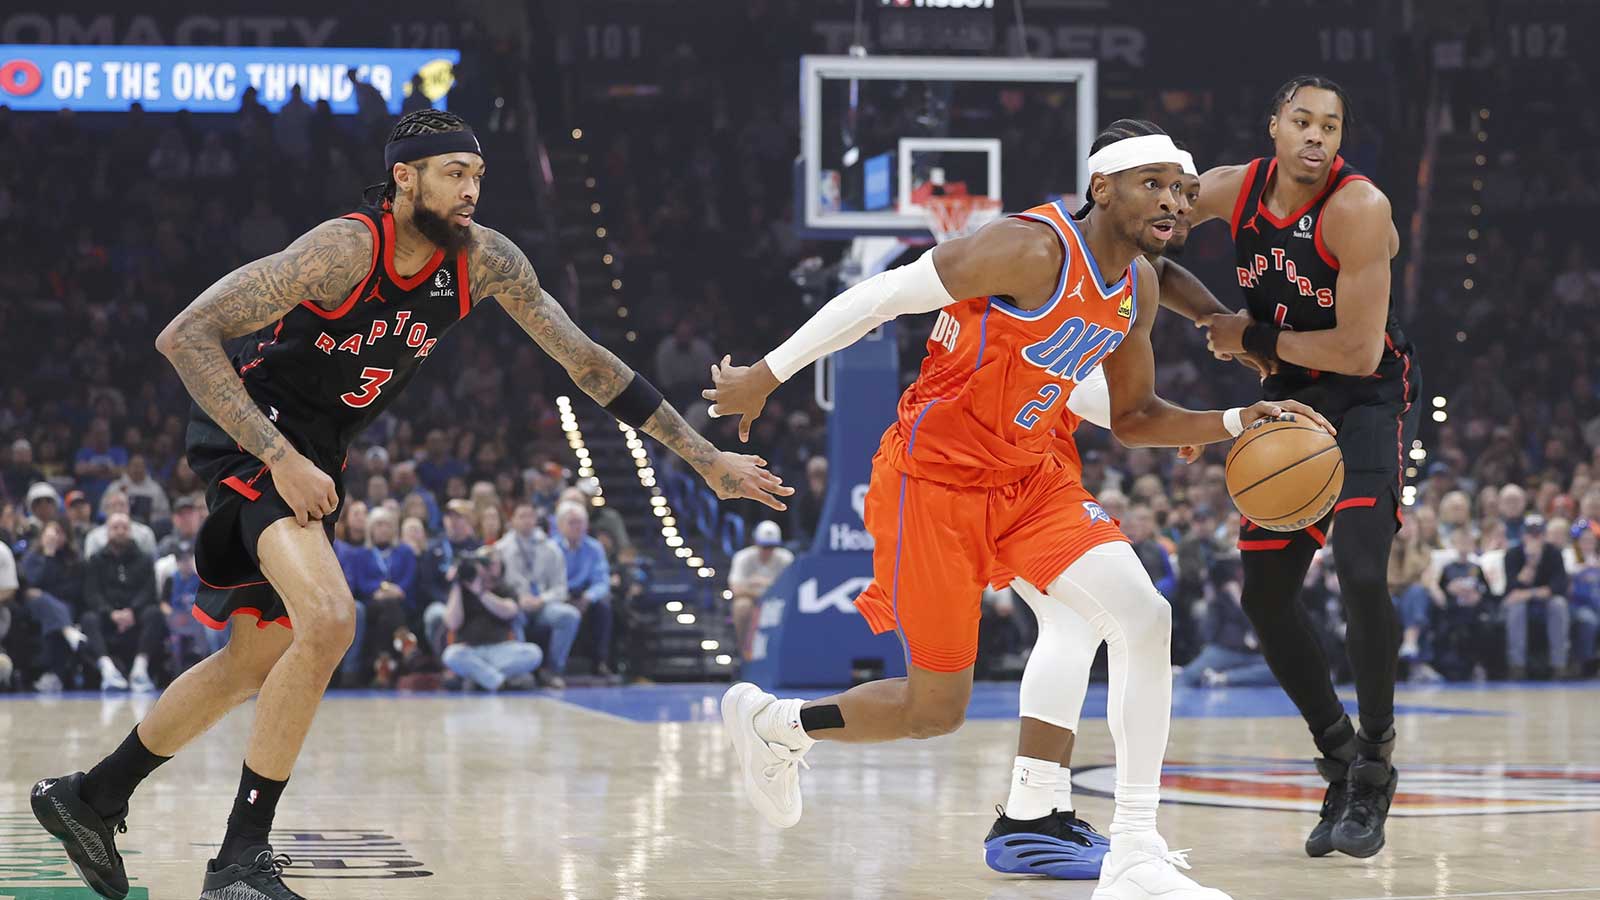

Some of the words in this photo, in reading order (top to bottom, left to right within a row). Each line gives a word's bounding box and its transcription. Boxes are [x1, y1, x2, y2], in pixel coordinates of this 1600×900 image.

[52, 61, 93, 100] OF
[102, 61, 162, 100] THE
[172, 62, 236, 101] OKC
[1236, 247, 1334, 307] RAPTORS
[315, 311, 437, 361] RAPTOR
[1021, 317, 1125, 384] OKC
[341, 367, 394, 408] 3
[1014, 384, 1061, 430] 2
